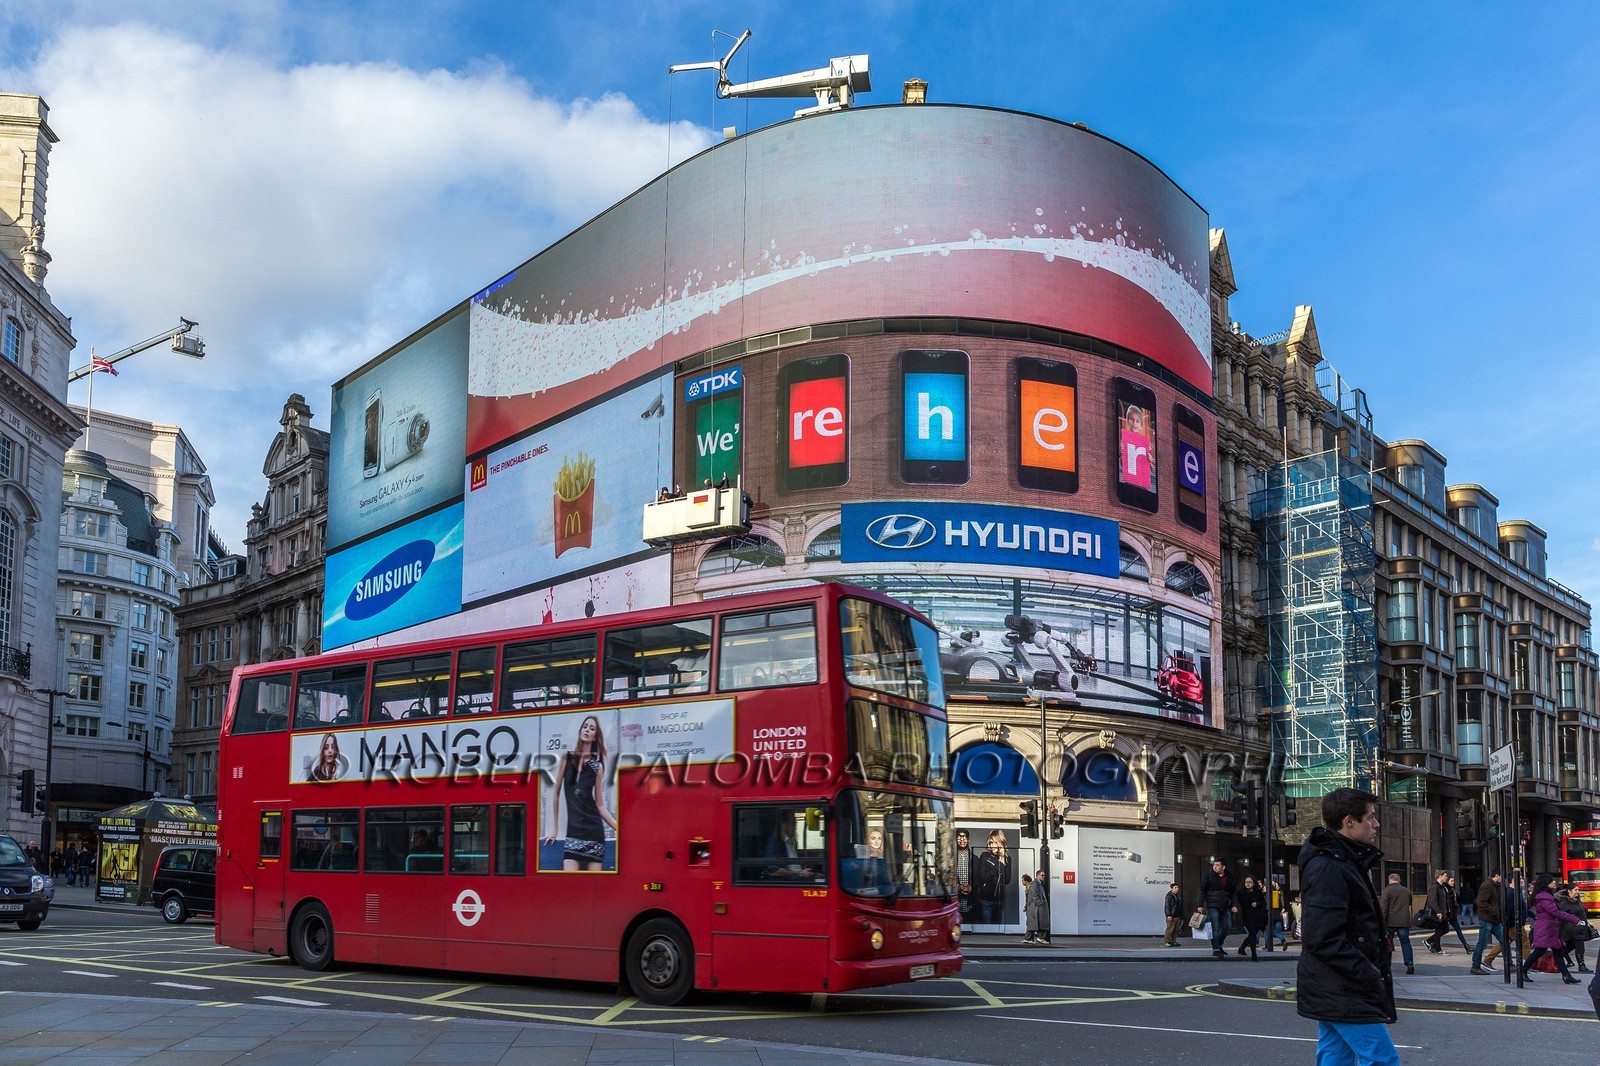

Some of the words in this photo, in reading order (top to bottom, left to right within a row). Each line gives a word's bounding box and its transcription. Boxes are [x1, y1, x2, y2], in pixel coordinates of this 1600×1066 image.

[700, 370, 738, 393] TDK
[9, 413, 21, 429] LIFE
[25, 426, 43, 445] OFFICE
[697, 423, 740, 457] We'
[793, 406, 843, 441] re
[918, 392, 954, 440] h
[1033, 408, 1068, 450] e
[1127, 442, 1147, 476] r
[1184, 450, 1200, 484] e
[489, 464, 500, 476] THE
[500, 450, 532, 471] PINCHABLE
[532, 443, 549, 458] ONES.
[359, 495, 378, 509] Samsung
[378, 478, 404, 500] GALAXY
[945, 519, 1101, 560] HYUNDAI
[355, 559, 423, 603] SAMSUNG
[647, 721, 704, 735] MANGO.COM
[660, 713, 679, 721] SHOP
[680, 711, 689, 719] AT
[753, 726, 807, 739] LONDON
[753, 738, 807, 752] UNITED
[359, 725, 520, 773] MANGO
